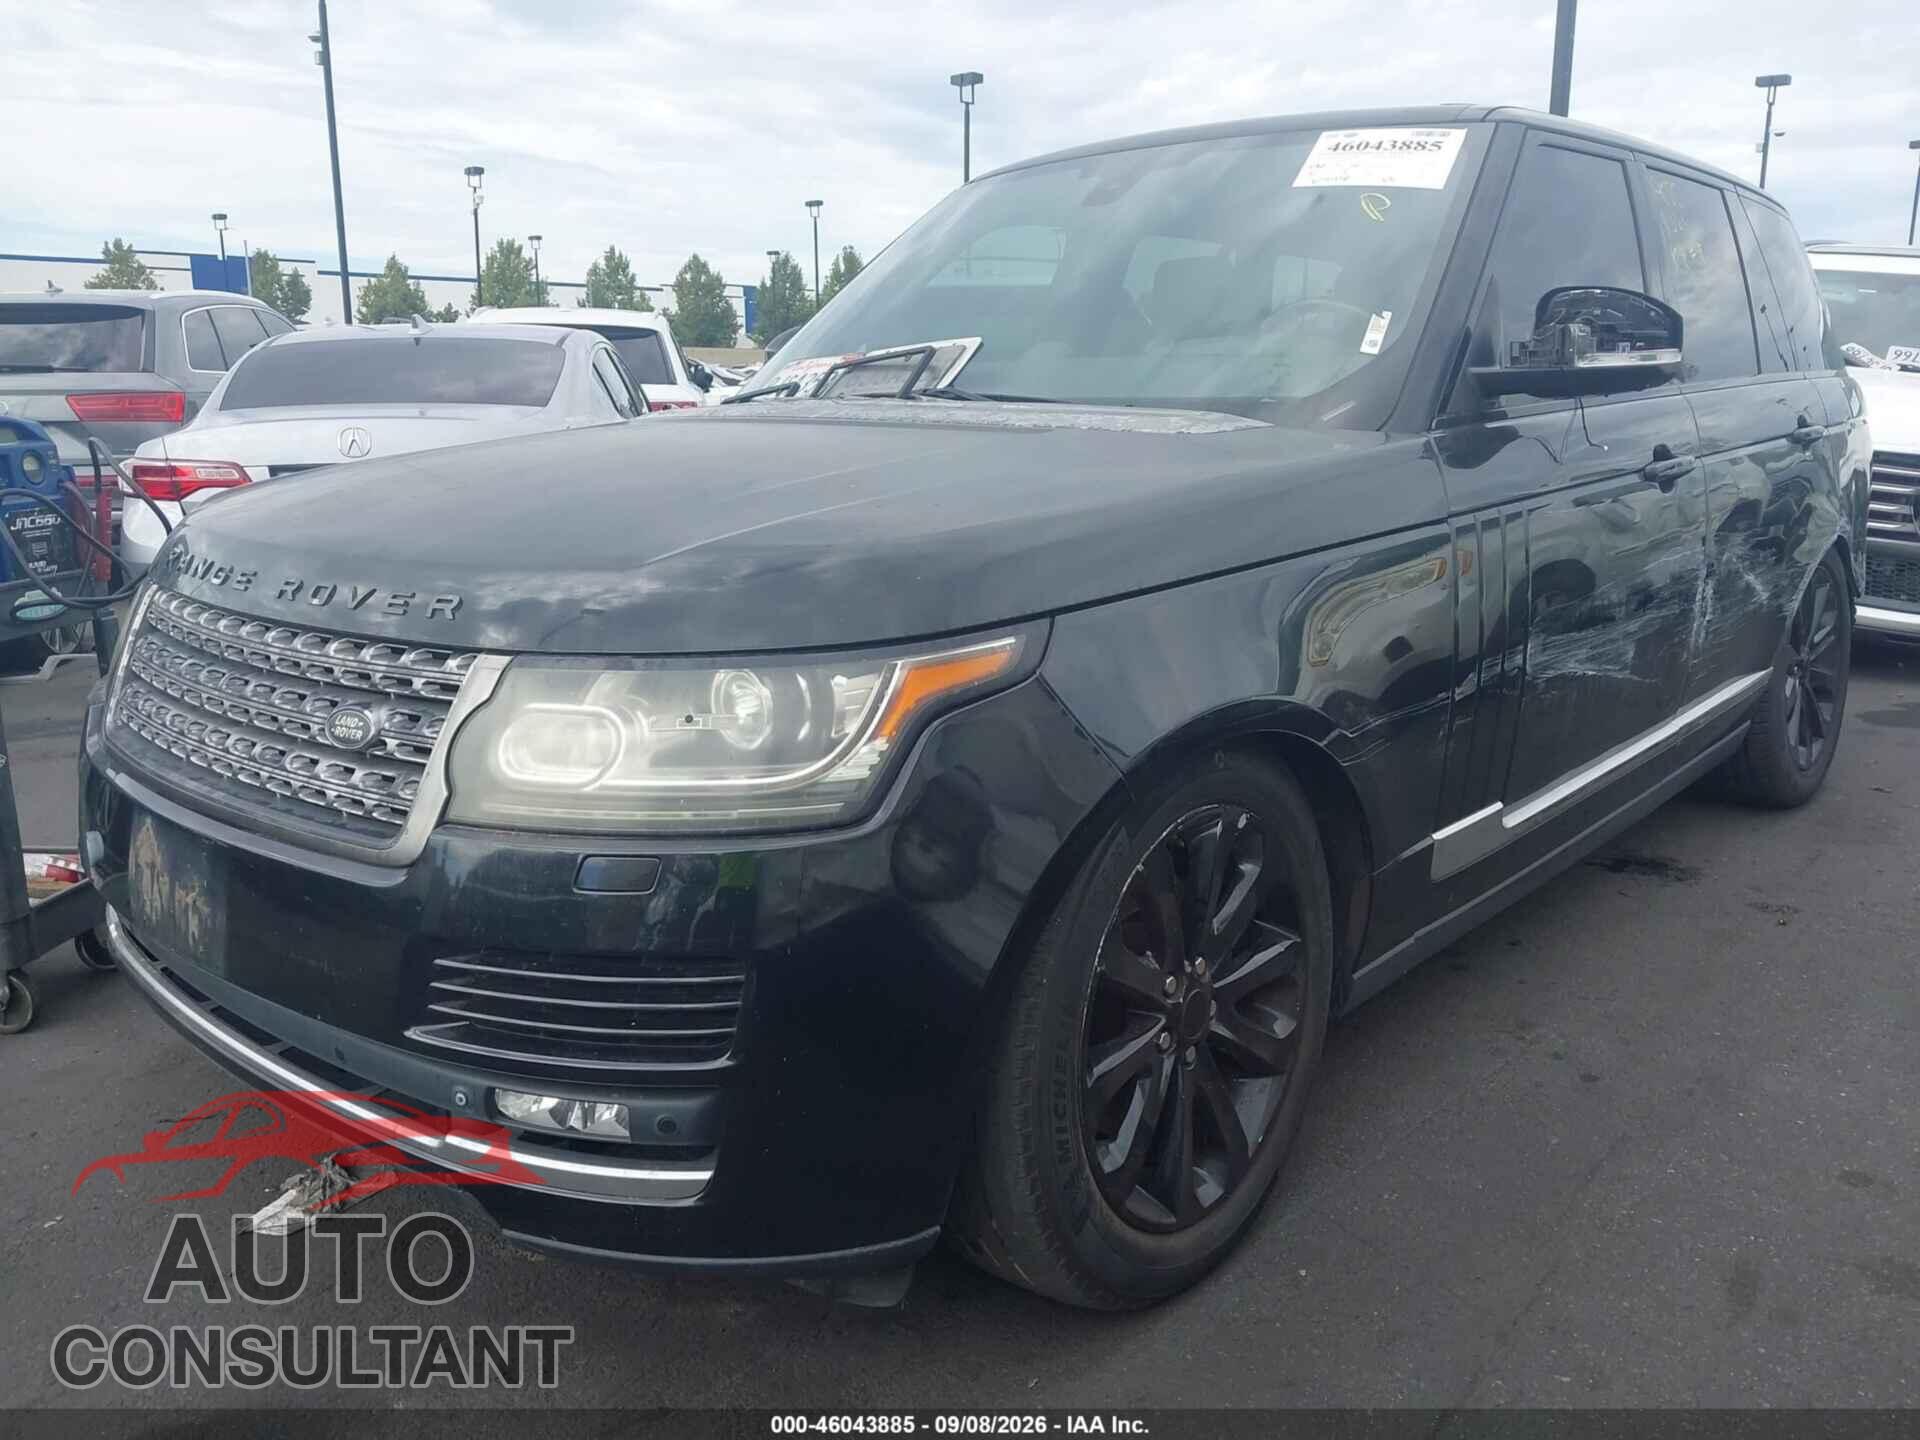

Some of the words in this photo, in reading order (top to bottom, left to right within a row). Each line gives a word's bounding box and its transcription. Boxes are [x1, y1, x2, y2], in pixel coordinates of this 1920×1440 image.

[1327, 139, 1445, 153] 46043885
[167, 544, 258, 593] RANGE
[276, 578, 464, 621] ROVER
[335, 726, 364, 740] ROVER
